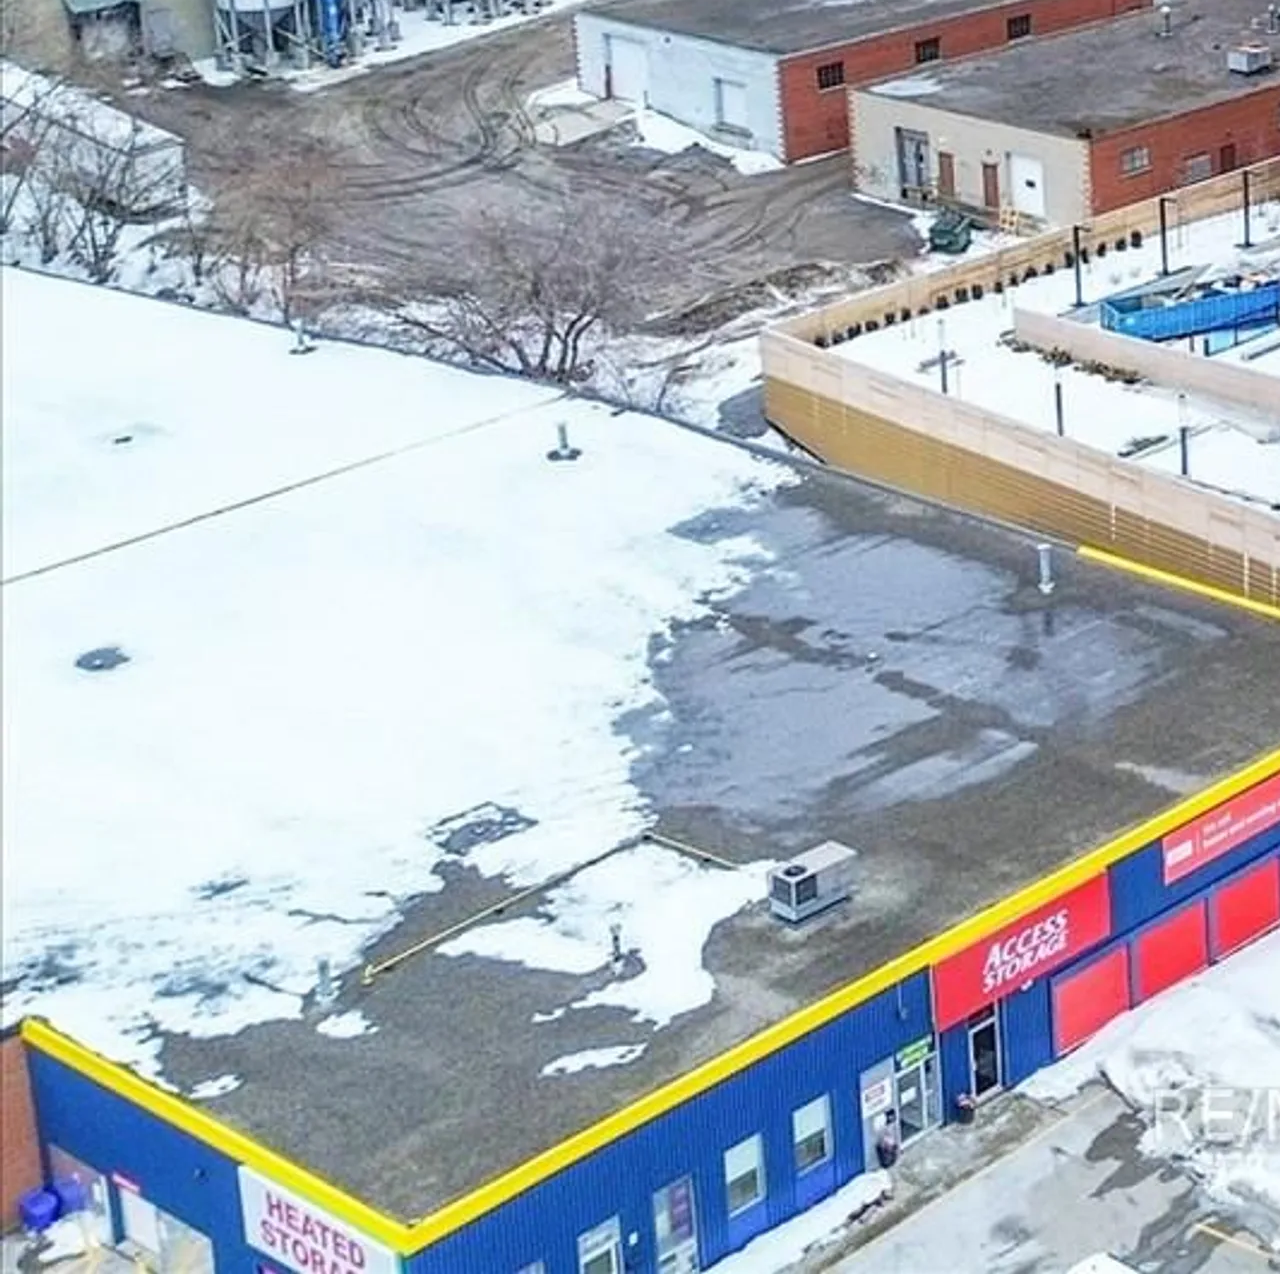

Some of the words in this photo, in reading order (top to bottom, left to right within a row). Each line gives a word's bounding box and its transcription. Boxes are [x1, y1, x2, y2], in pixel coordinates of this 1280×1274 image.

[982, 908, 1069, 976] ACCESS
[982, 929, 1069, 994] STORAGE
[265, 1189, 366, 1270] HEATED
